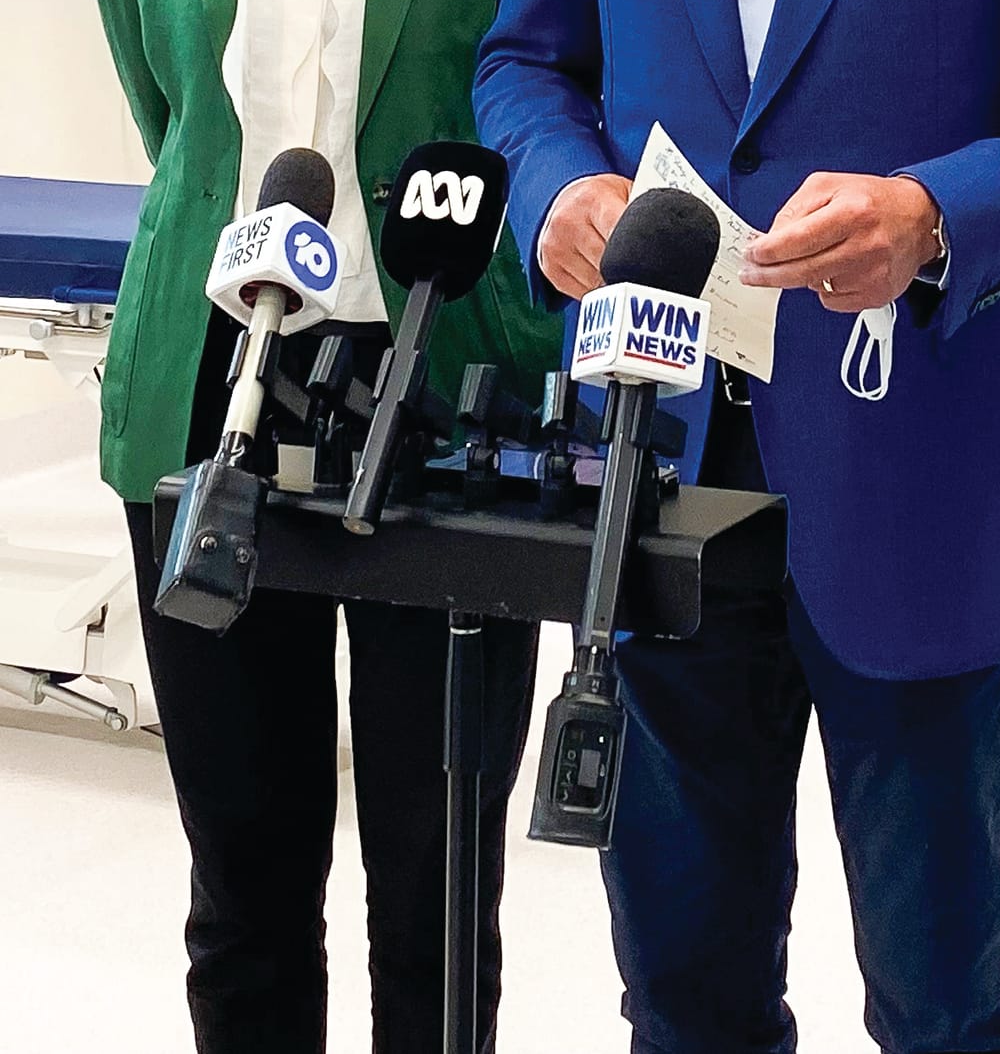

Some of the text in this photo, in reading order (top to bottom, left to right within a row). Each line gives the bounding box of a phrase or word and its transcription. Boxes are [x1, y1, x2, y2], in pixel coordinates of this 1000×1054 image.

[227, 216, 273, 248] NEWS
[220, 239, 268, 271] FIRST
[583, 296, 616, 334] WIN
[630, 295, 701, 343] WIN
[578, 331, 612, 357] NEWS
[626, 331, 697, 365] NEWS
